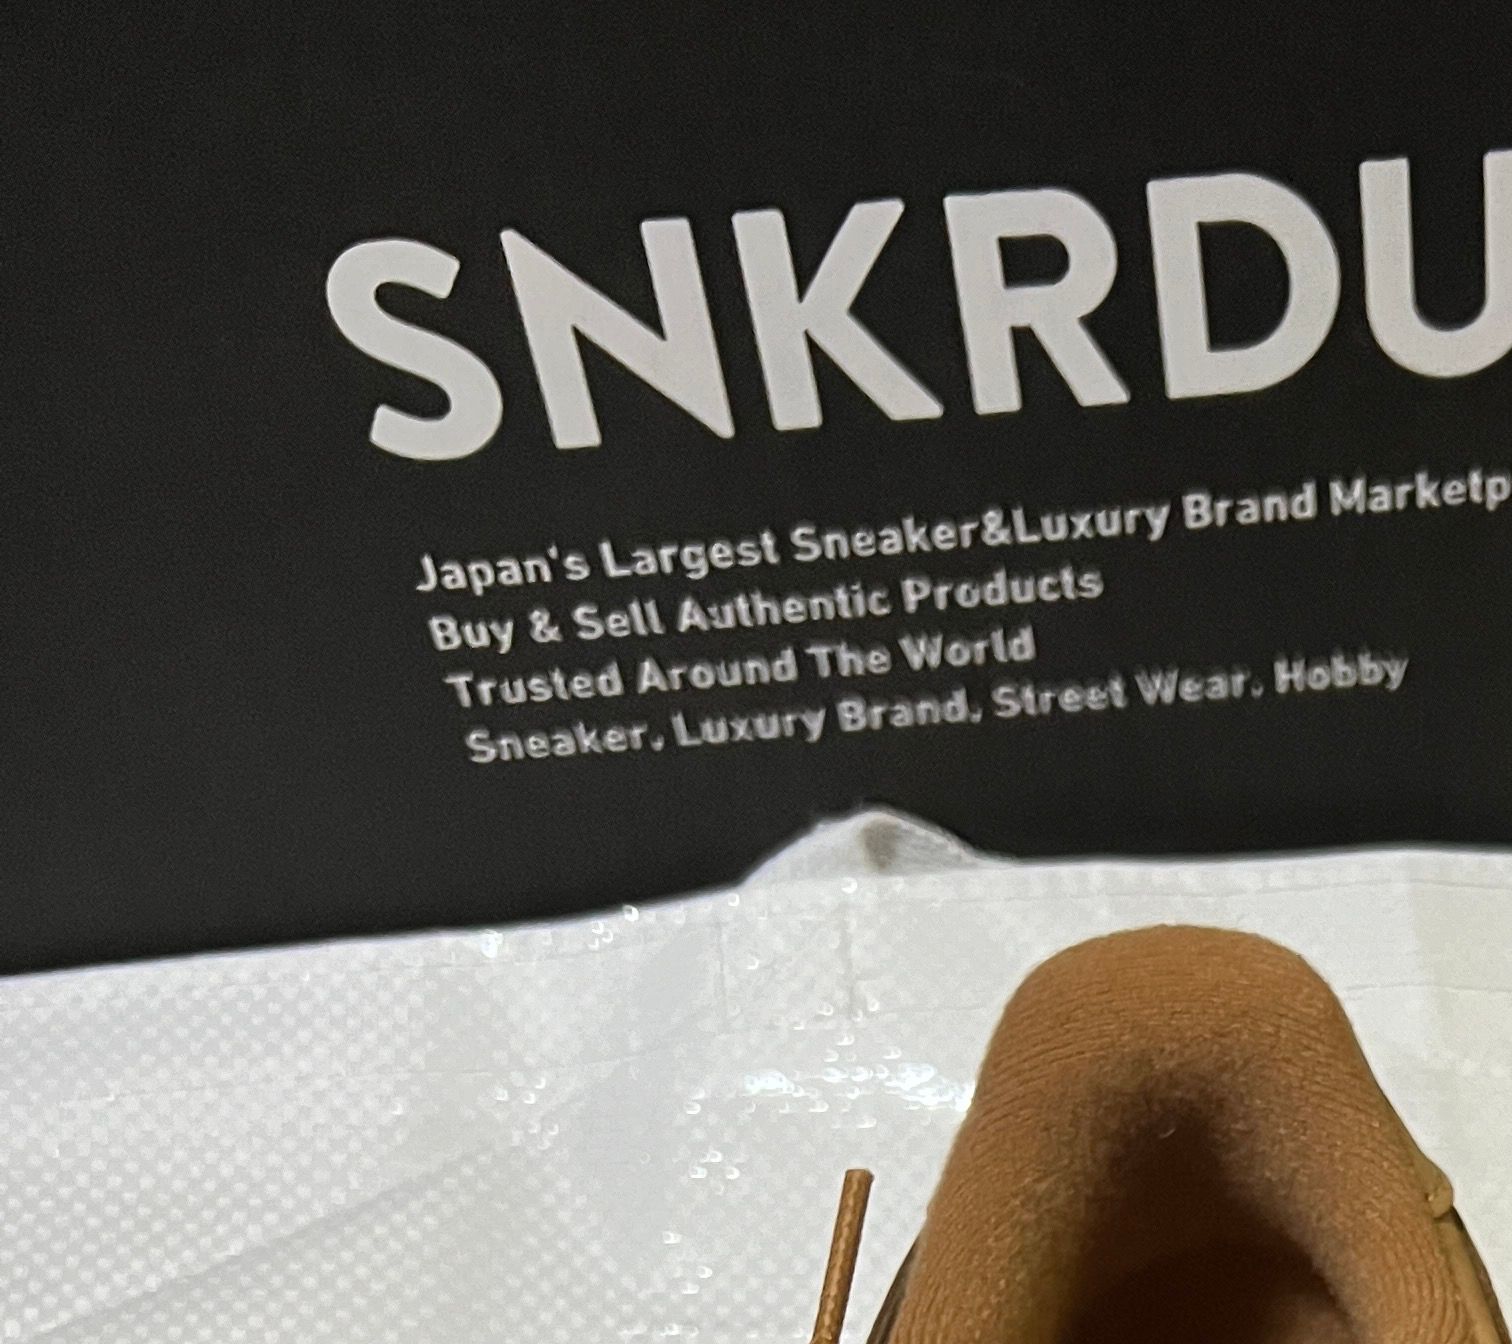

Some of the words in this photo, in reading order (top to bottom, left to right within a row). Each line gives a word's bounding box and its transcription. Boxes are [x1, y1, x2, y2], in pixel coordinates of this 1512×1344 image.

[416, 542, 590, 596] Japan's
[599, 528, 781, 580] Largest
[790, 504, 1171, 562] Sneaker&Luxury
[1182, 480, 1317, 529] Brand
[428, 615, 514, 654] Buy
[529, 607, 562, 643] &
[572, 598, 665, 640] Sell
[677, 582, 892, 632] Authentic
[901, 564, 1104, 613] Products
[443, 660, 625, 708] Trusted
[638, 646, 798, 694] Around
[806, 641, 892, 679] The
[898, 624, 1037, 671] World
[671, 706, 826, 747] Luxury
[991, 672, 1128, 718] Street
[1273, 646, 1410, 694] Hobby
